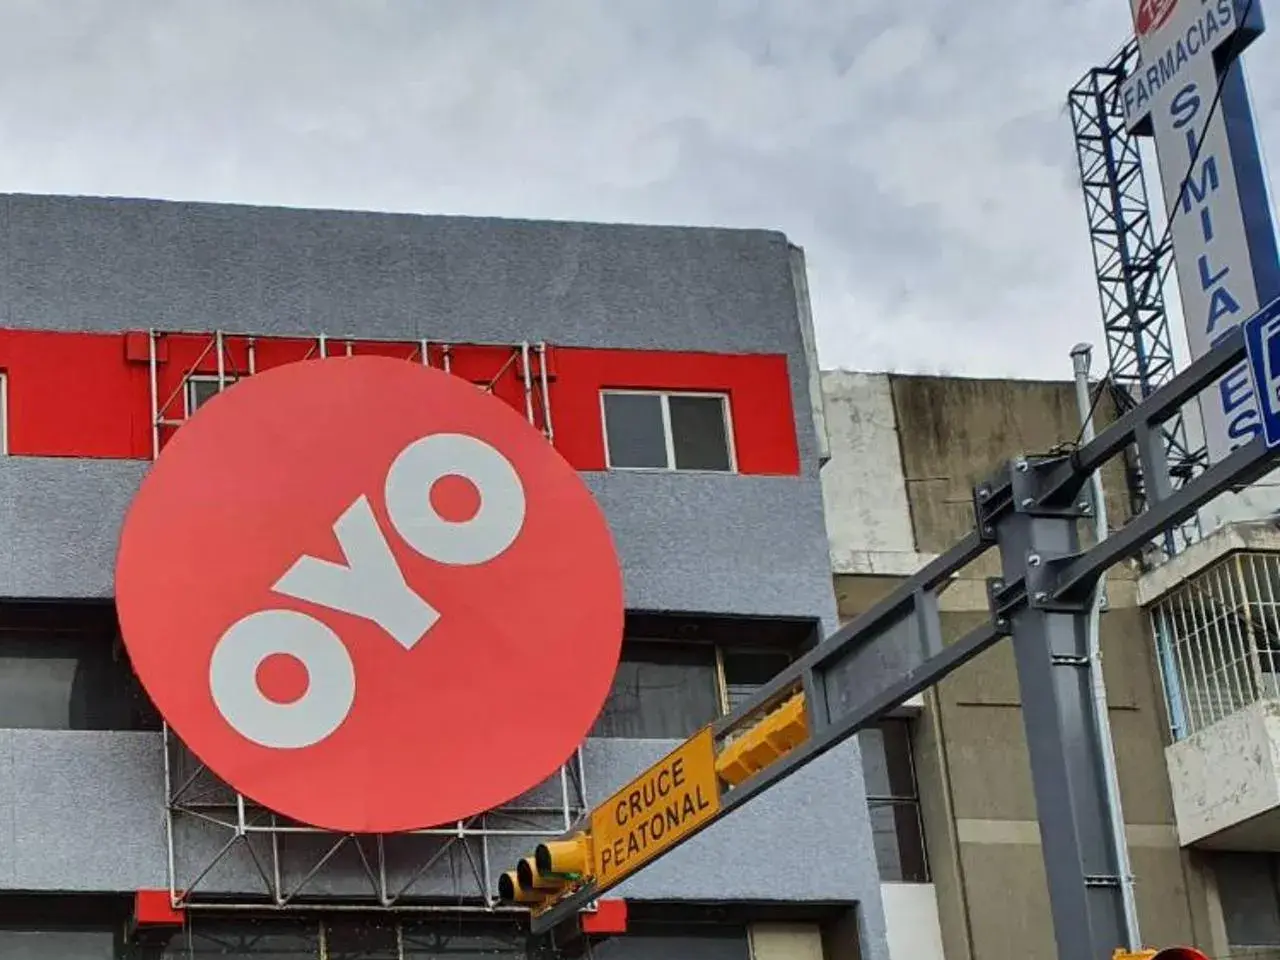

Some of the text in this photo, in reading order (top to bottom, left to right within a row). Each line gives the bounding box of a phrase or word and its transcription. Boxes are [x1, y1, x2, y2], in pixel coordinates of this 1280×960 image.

[1124, 0, 1232, 118] FARMACIAS
[1170, 84, 1262, 452] SIMILAES
[209, 432, 525, 749] OYO
[600, 783, 709, 875] PEATONAL
[615, 757, 685, 826] CRUCE
